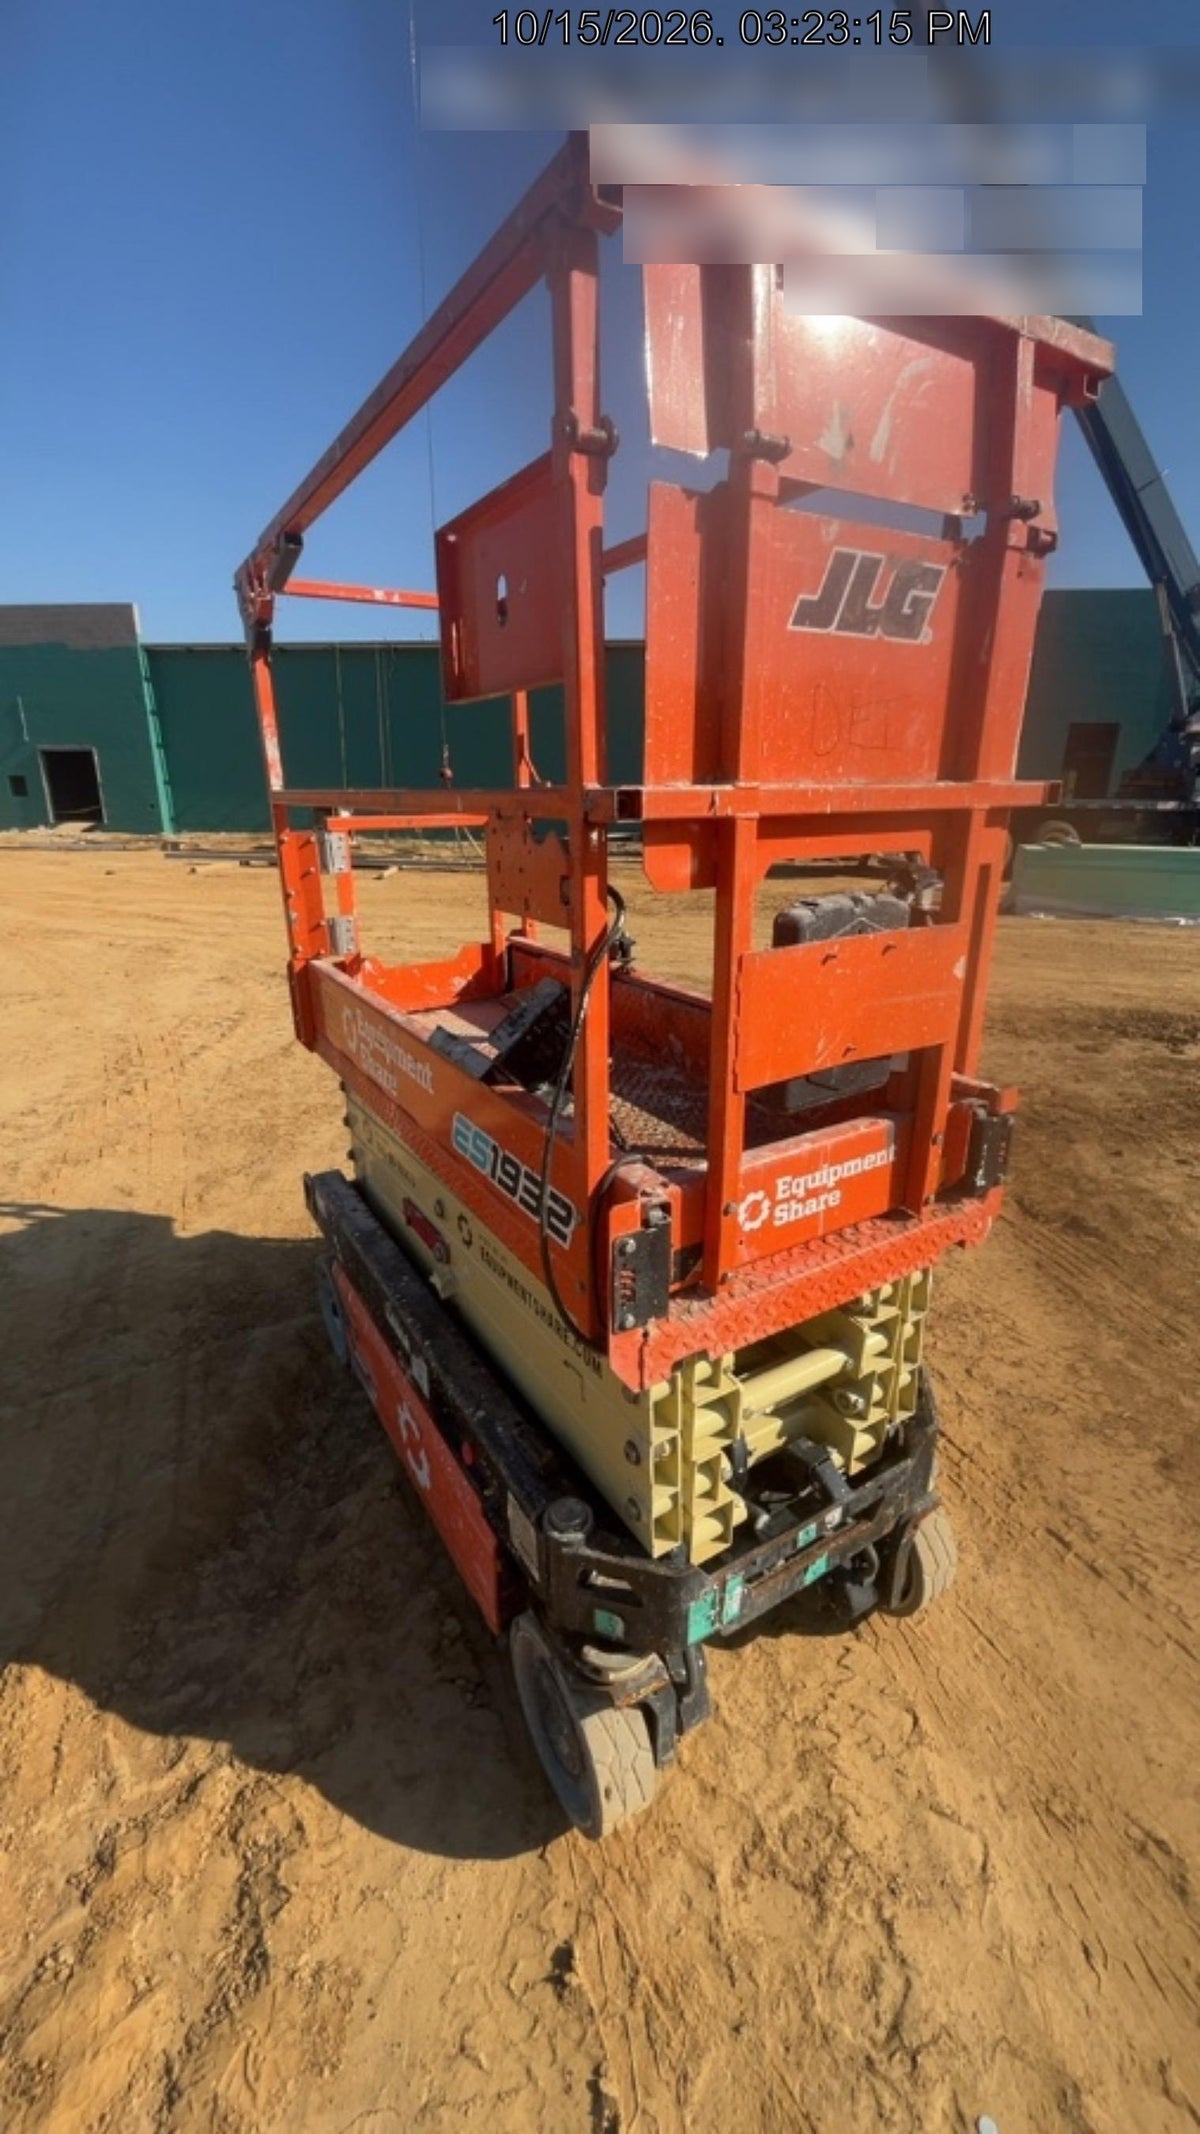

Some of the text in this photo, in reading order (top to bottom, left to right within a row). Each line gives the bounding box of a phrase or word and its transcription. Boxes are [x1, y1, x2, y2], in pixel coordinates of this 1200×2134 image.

[787, 547, 947, 644] JLG
[452, 1111, 577, 1250] ES1932
[773, 1190, 842, 1228] Share
[776, 1144, 896, 1200] Equipment
